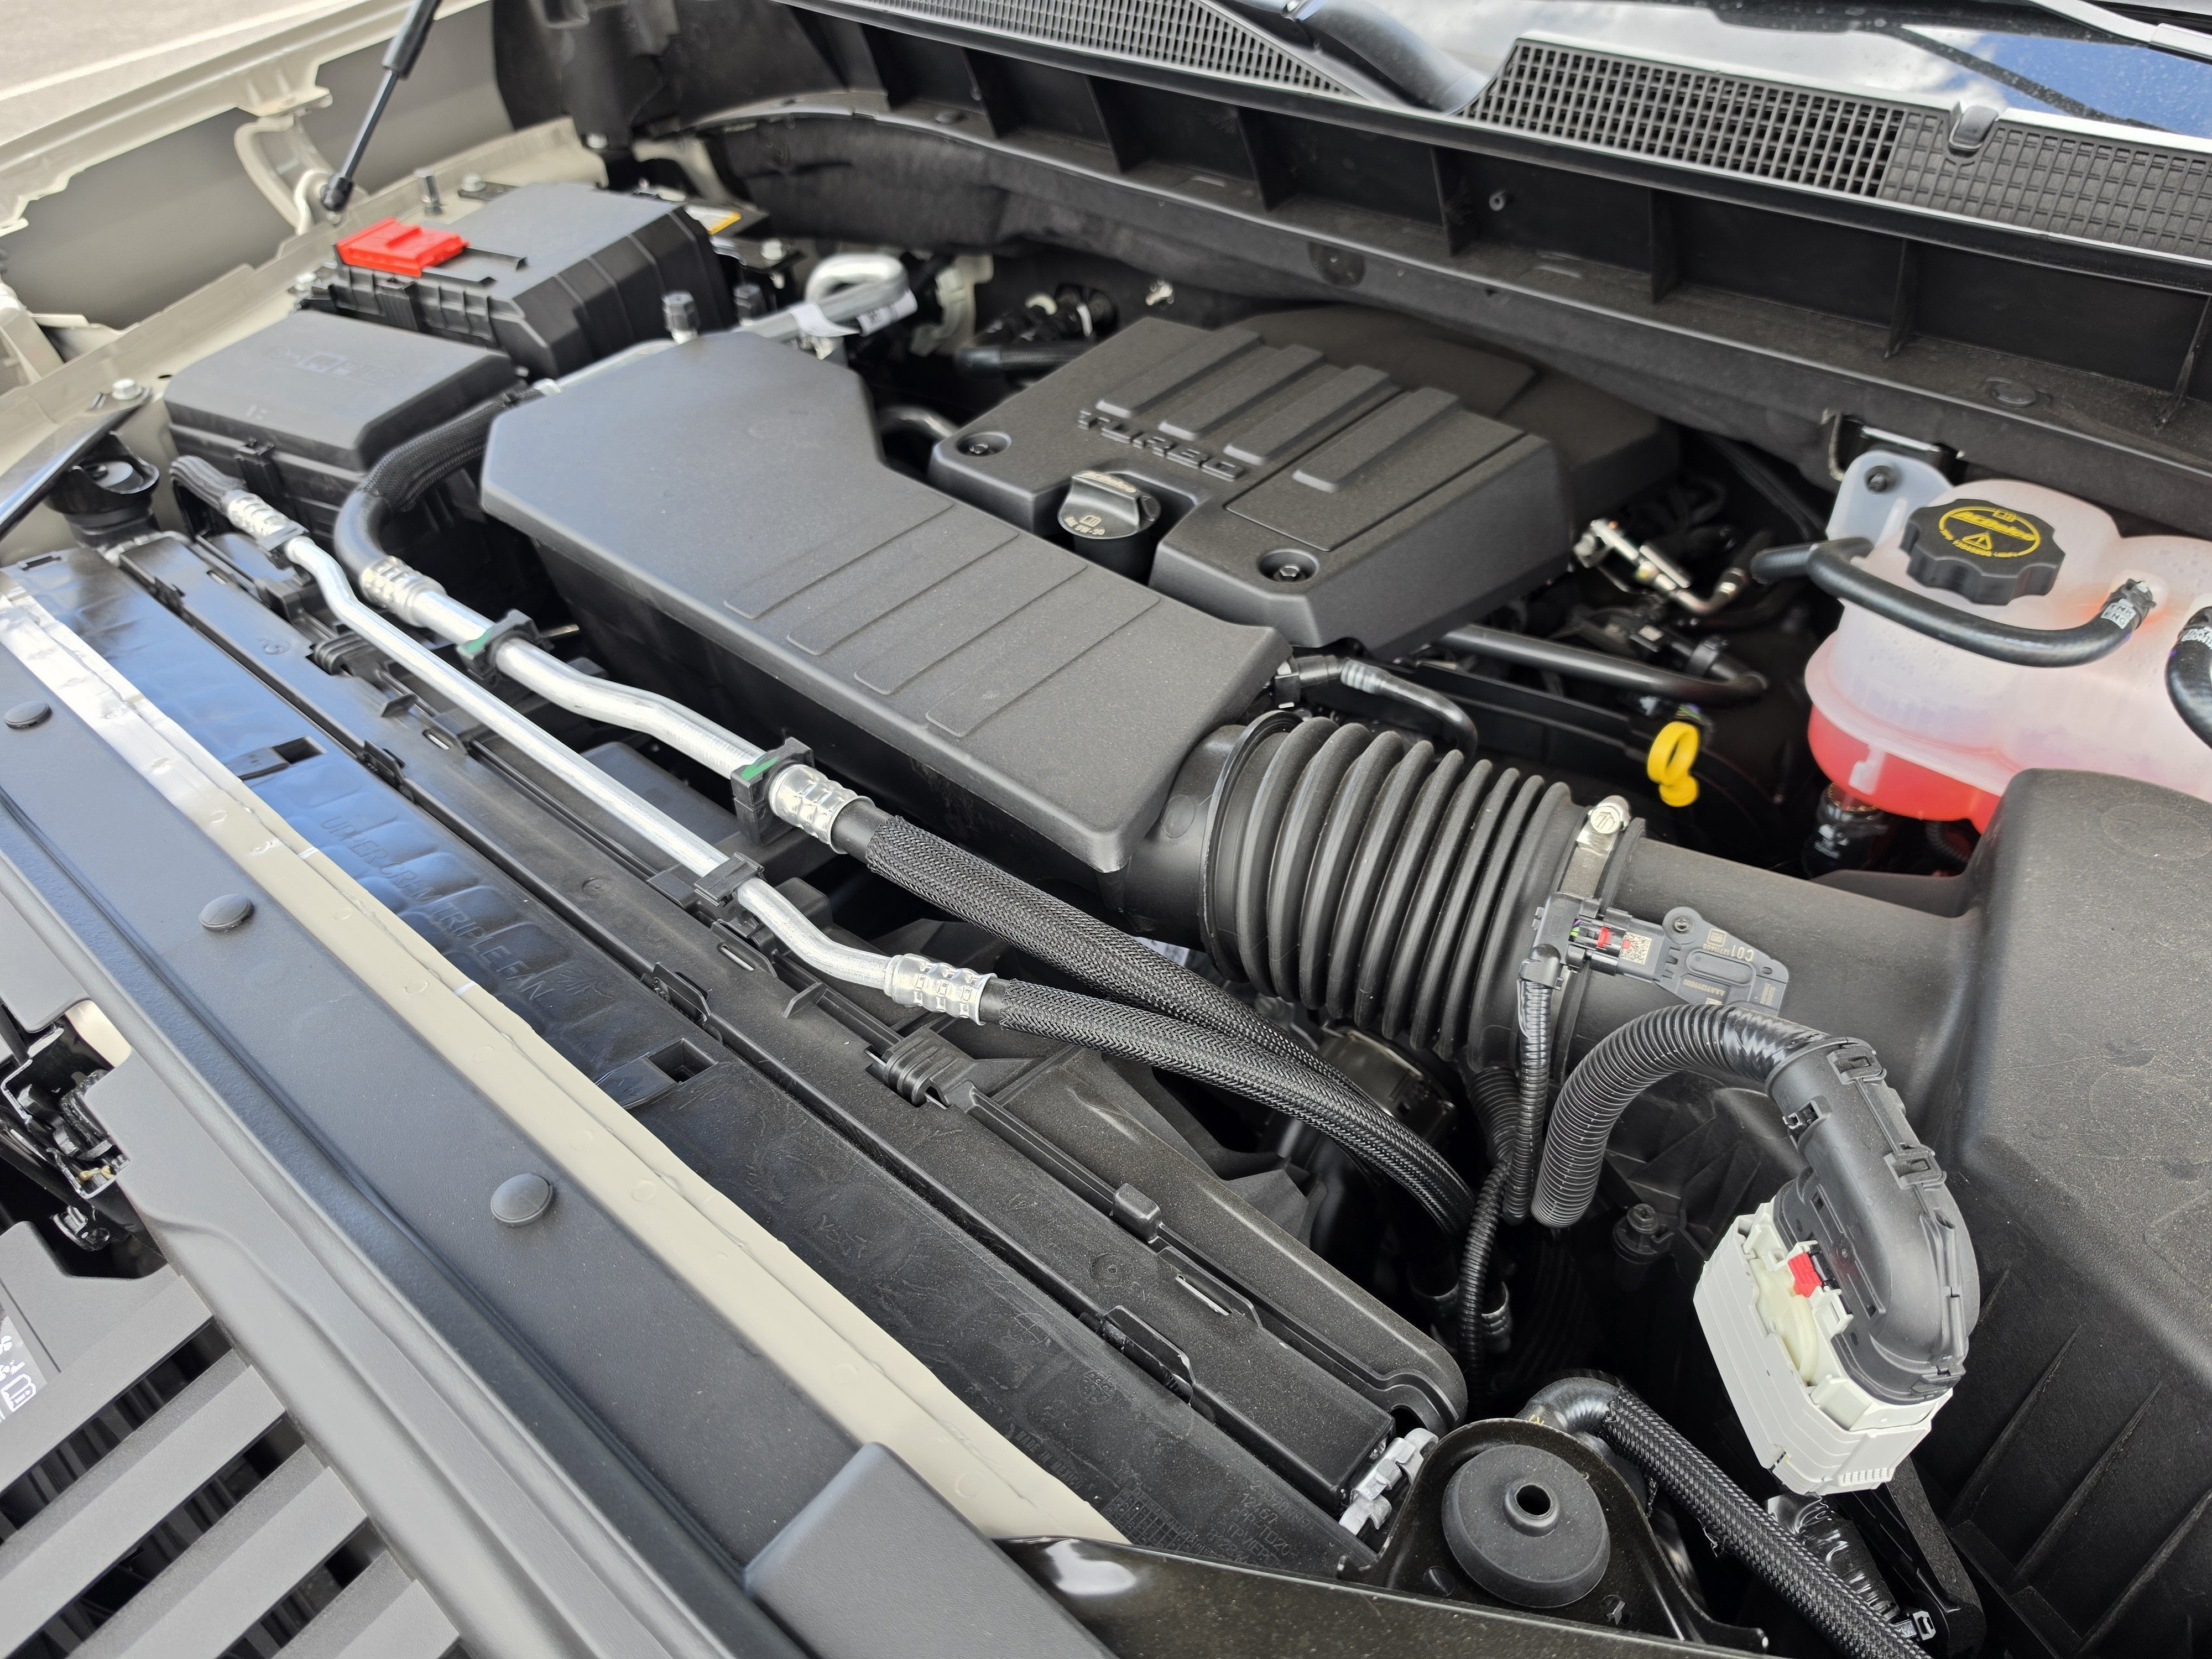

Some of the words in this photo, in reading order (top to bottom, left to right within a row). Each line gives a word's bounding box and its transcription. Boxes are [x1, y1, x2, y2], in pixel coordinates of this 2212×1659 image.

[1077, 408, 1246, 482] TURBO
[2110, 604, 2133, 617] TNK
[320, 816, 387, 864] UPPER
[431, 901, 512, 966] TRIPLE
[495, 960, 556, 1001] FAN
[1731, 944, 1755, 962] C01
[1050, 1460, 1082, 1489] MEXICO
